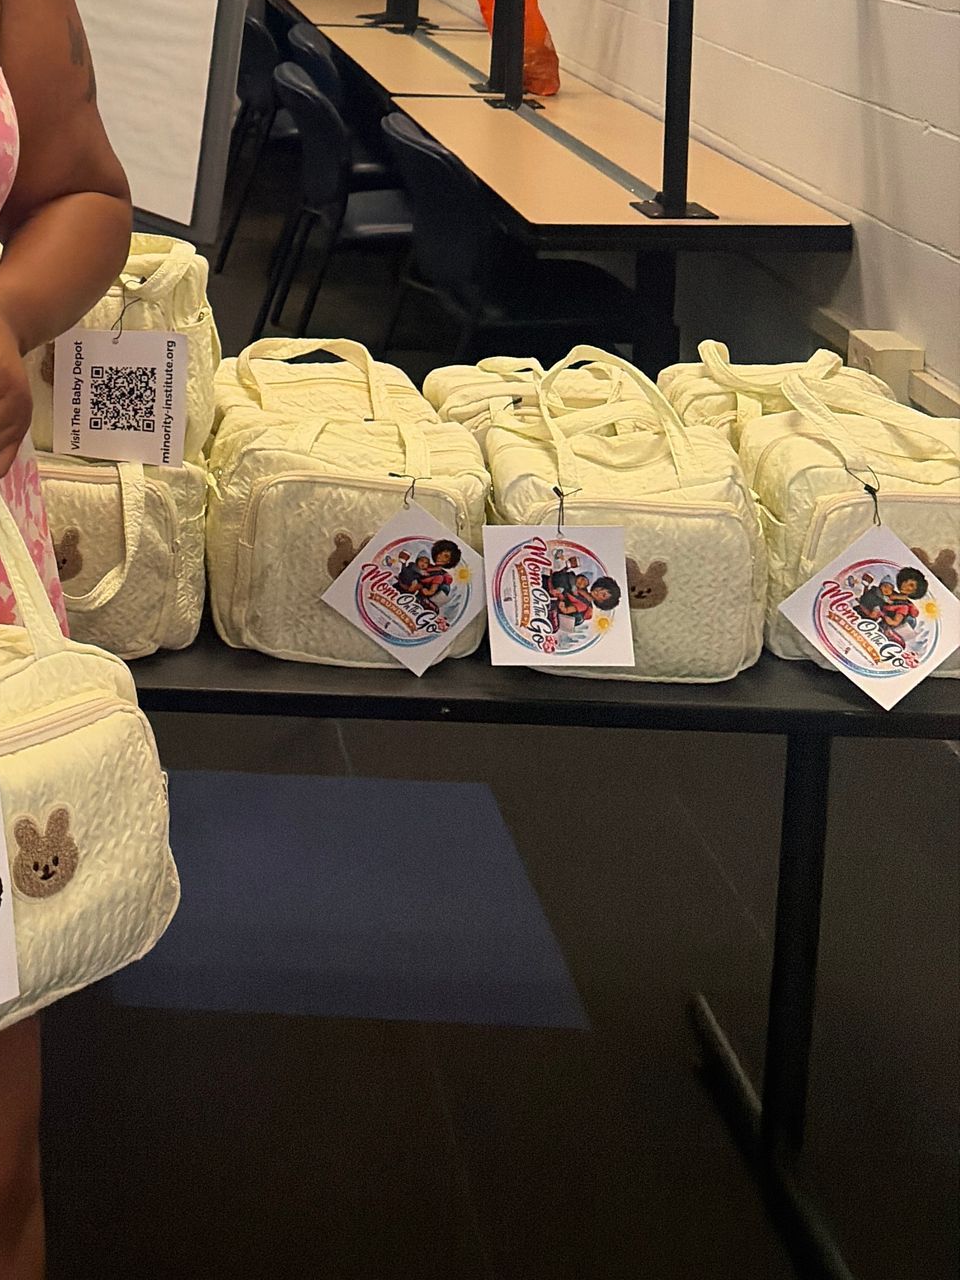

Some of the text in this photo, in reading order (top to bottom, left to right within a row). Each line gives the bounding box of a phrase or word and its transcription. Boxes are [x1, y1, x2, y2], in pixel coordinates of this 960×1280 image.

[70, 340, 85, 451] Visit The Baby Depot
[160, 340, 176, 463] minority-institute.org
[523, 536, 552, 587] Mom
[361, 563, 399, 601] Mom
[396, 595, 415, 610] On
[415, 611, 441, 634] Go
[521, 575, 530, 616] BUNDLE
[531, 588, 550, 608] On
[821, 581, 860, 625] Mom
[857, 621, 878, 638] On
[879, 643, 910, 669] Go
[527, 618, 553, 650] Go
